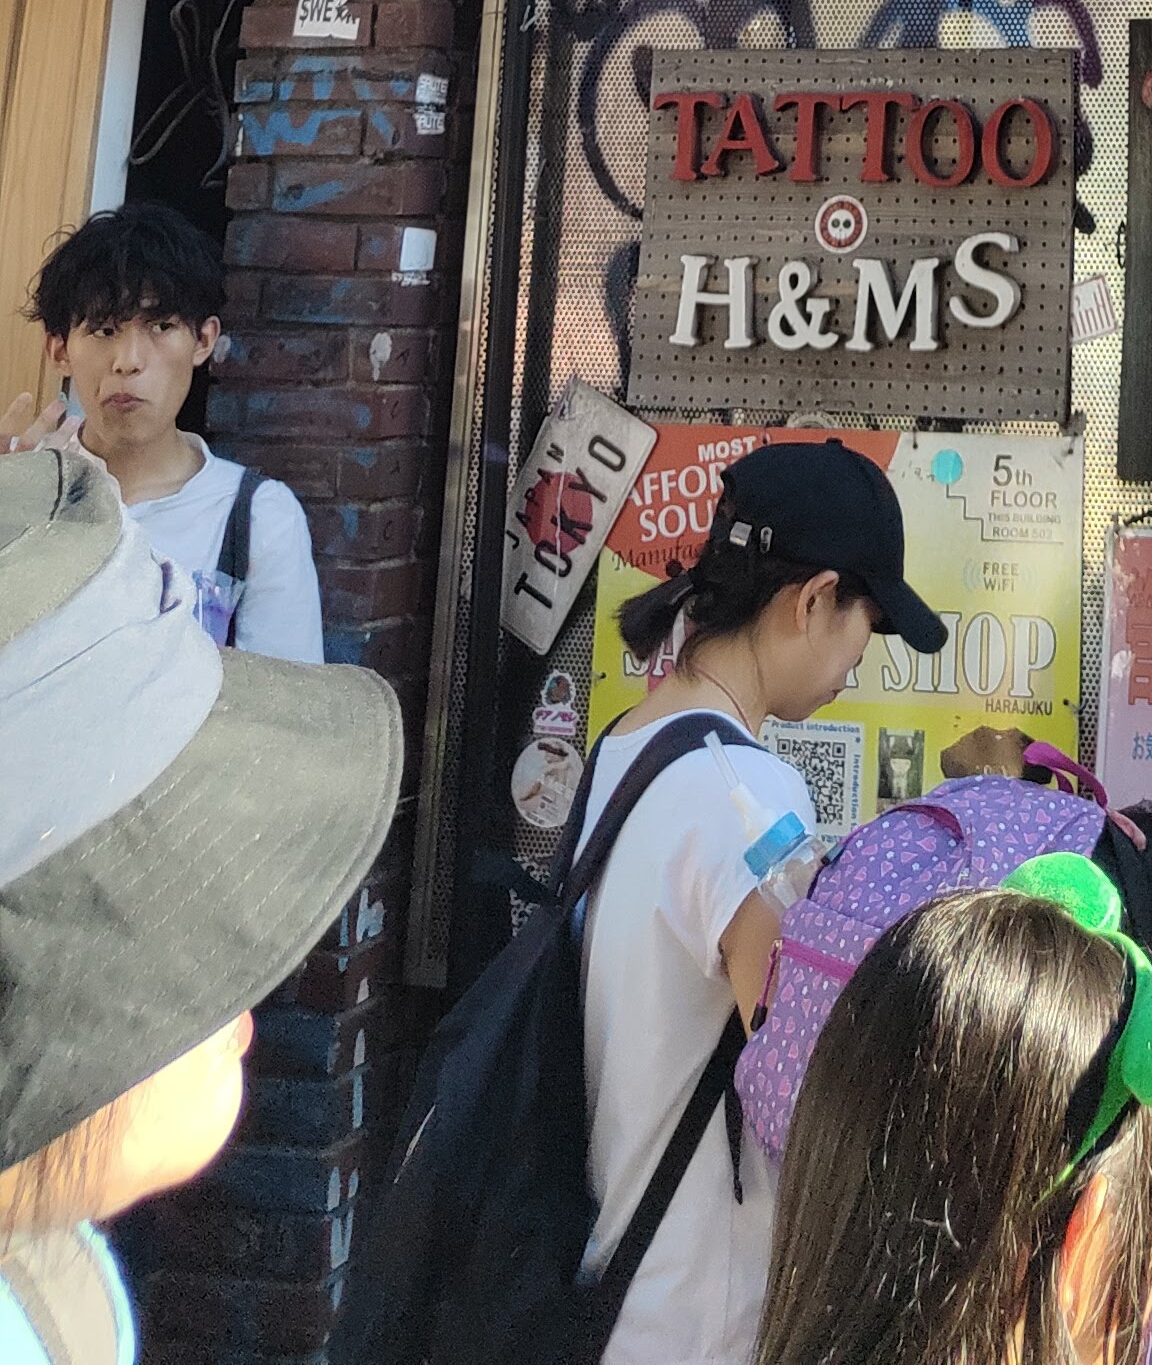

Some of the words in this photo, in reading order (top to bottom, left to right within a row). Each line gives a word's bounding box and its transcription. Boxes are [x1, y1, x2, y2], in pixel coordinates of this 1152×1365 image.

[653, 92, 1055, 188] TATTOO
[669, 231, 1022, 352] H&MS
[698, 436, 757, 462] MOST
[992, 454, 1033, 487] 5th
[508, 442, 566, 550] JAPAN
[990, 490, 1057, 509] FLOOR
[515, 433, 627, 611] TOKYO
[988, 512, 1010, 523] THIS
[1012, 513, 1061, 524] BUILDING
[992, 527, 1029, 538] ROOM
[983, 562, 1019, 576] FREE
[983, 577, 1015, 592] WiFi
[881, 610, 1057, 699] SHOP
[984, 697, 1054, 716] HARAJUKU
